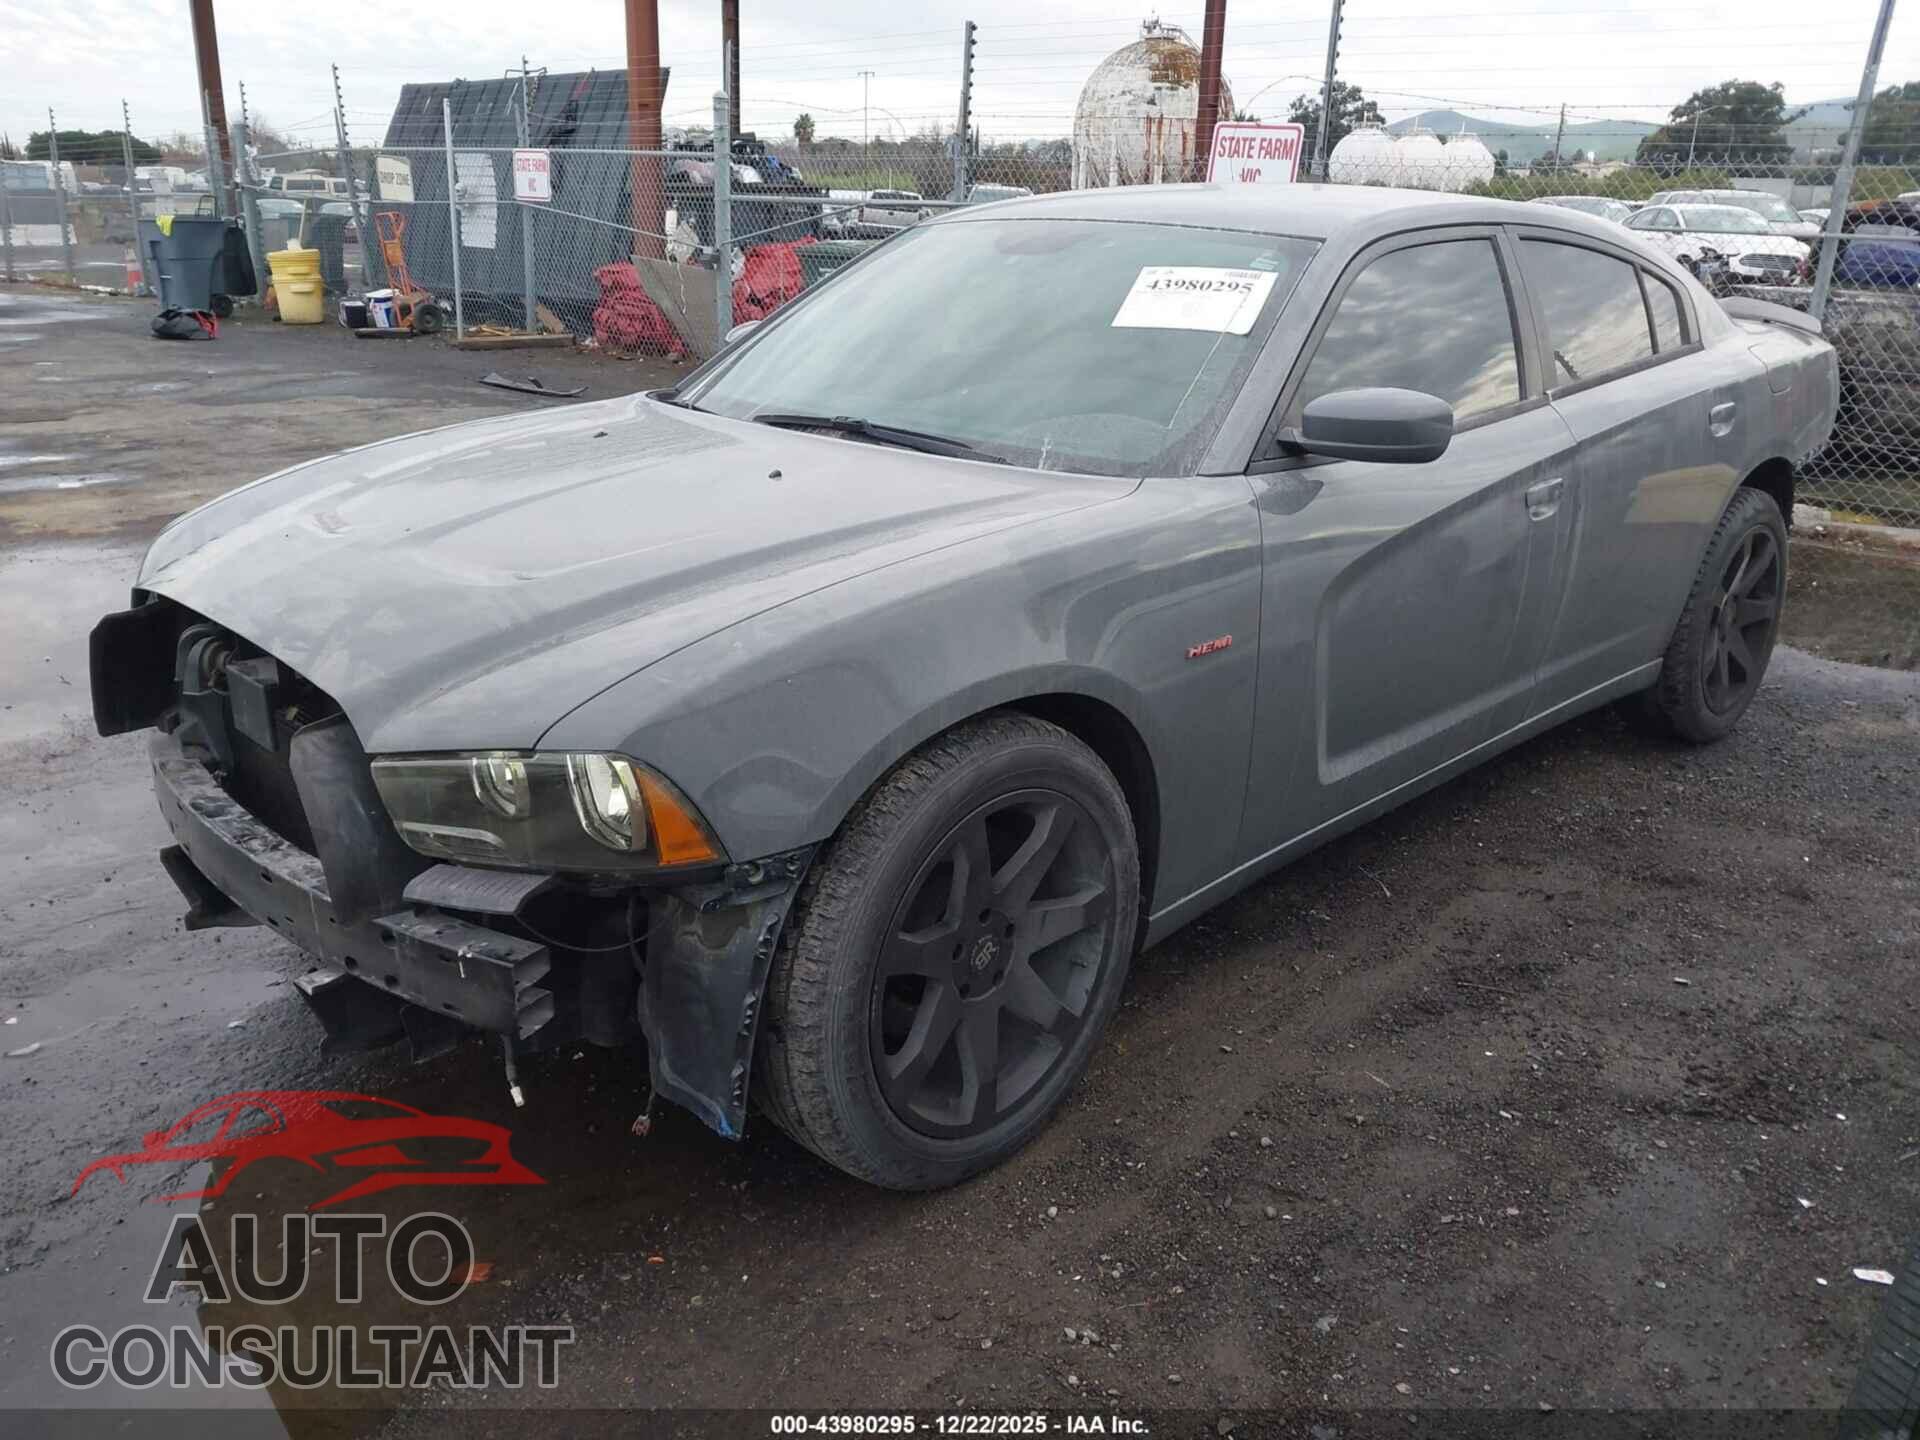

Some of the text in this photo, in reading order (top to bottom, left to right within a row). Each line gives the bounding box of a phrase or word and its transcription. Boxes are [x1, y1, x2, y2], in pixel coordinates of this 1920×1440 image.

[1217, 136, 1295, 161] STATE FARM
[516, 158, 531, 171] STATE
[1147, 278, 1255, 296] 43980295
